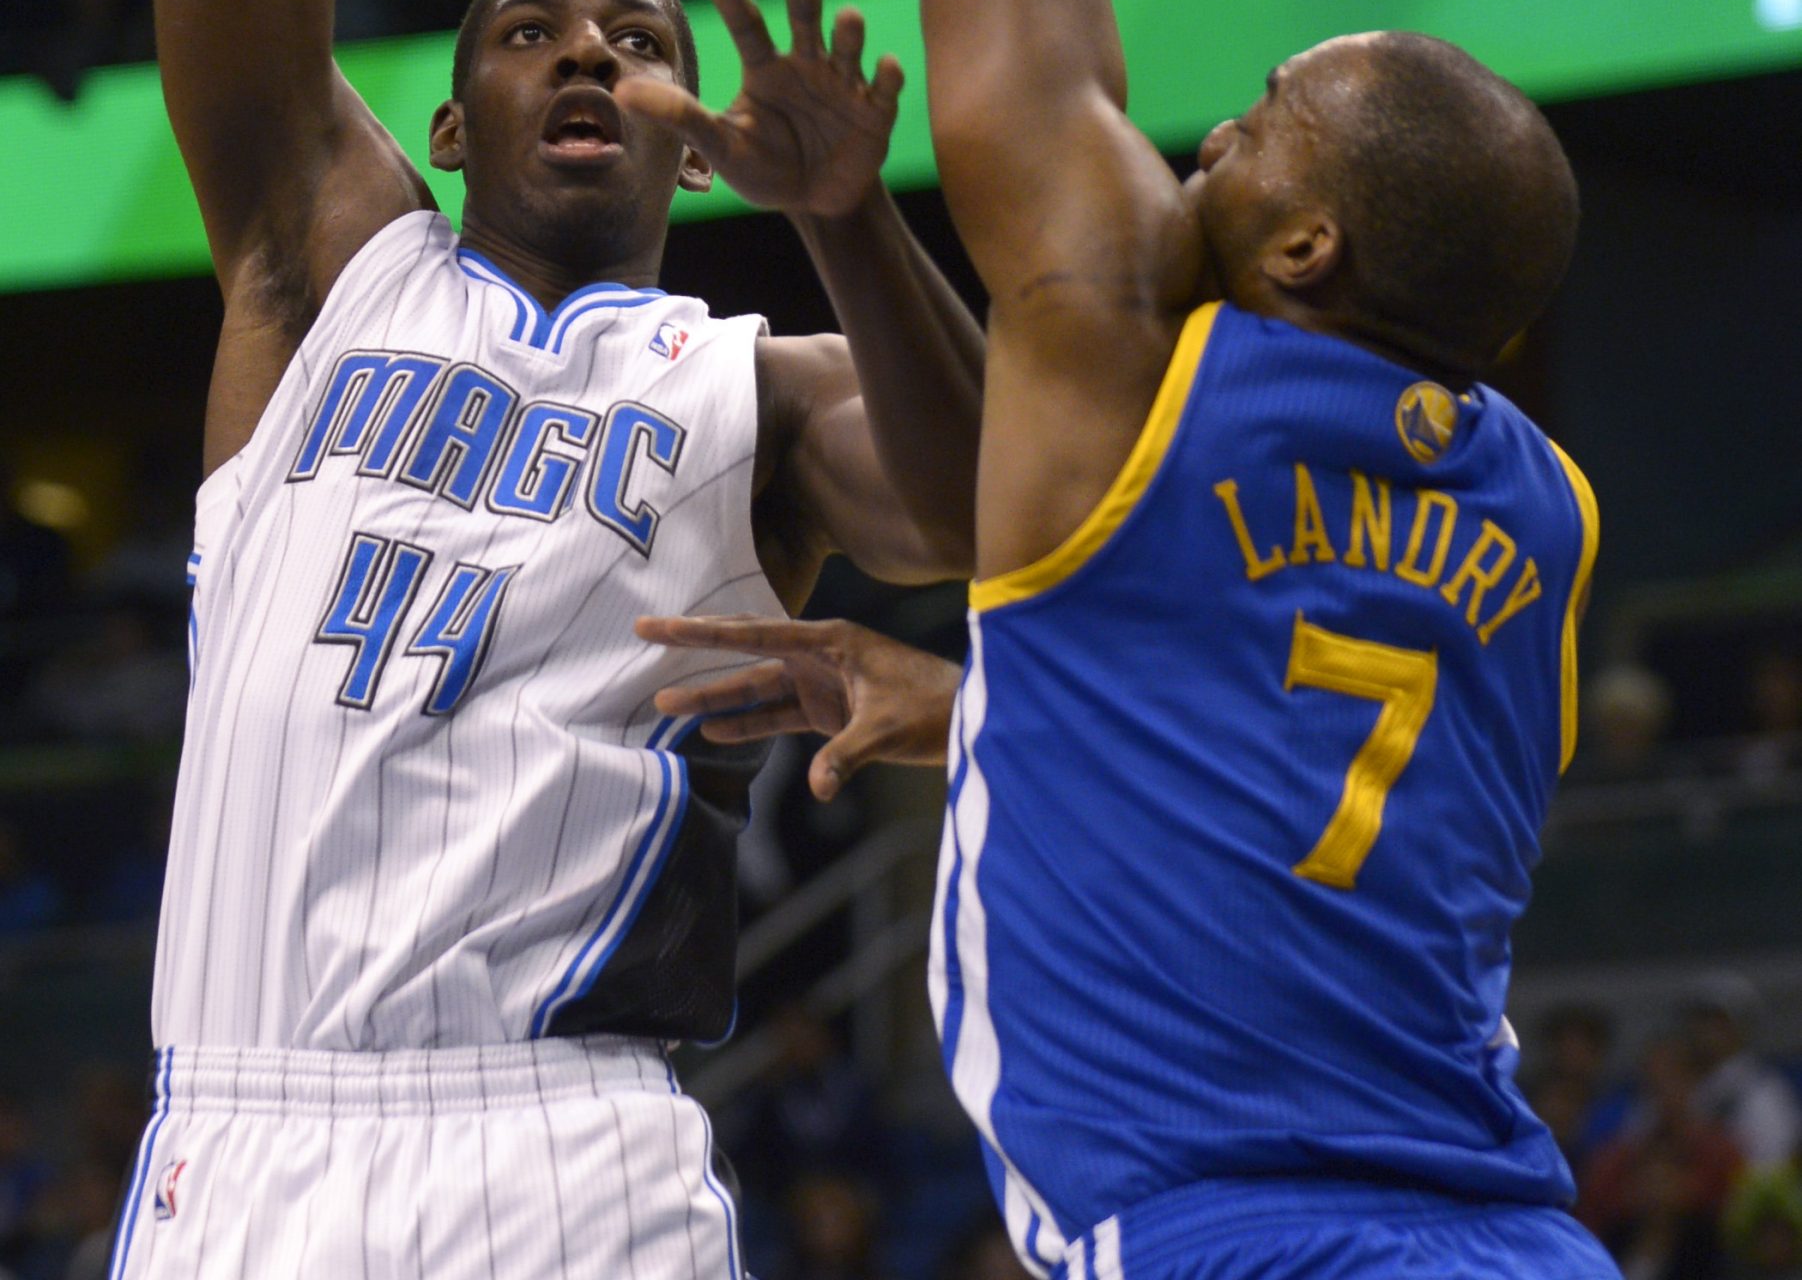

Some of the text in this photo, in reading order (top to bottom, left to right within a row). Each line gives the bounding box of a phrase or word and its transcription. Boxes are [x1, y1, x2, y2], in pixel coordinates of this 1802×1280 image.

[285, 348, 687, 560] MAGC
[313, 531, 523, 716] 44
[1214, 462, 1542, 645] LANDRY
[1285, 608, 1438, 889] 7
